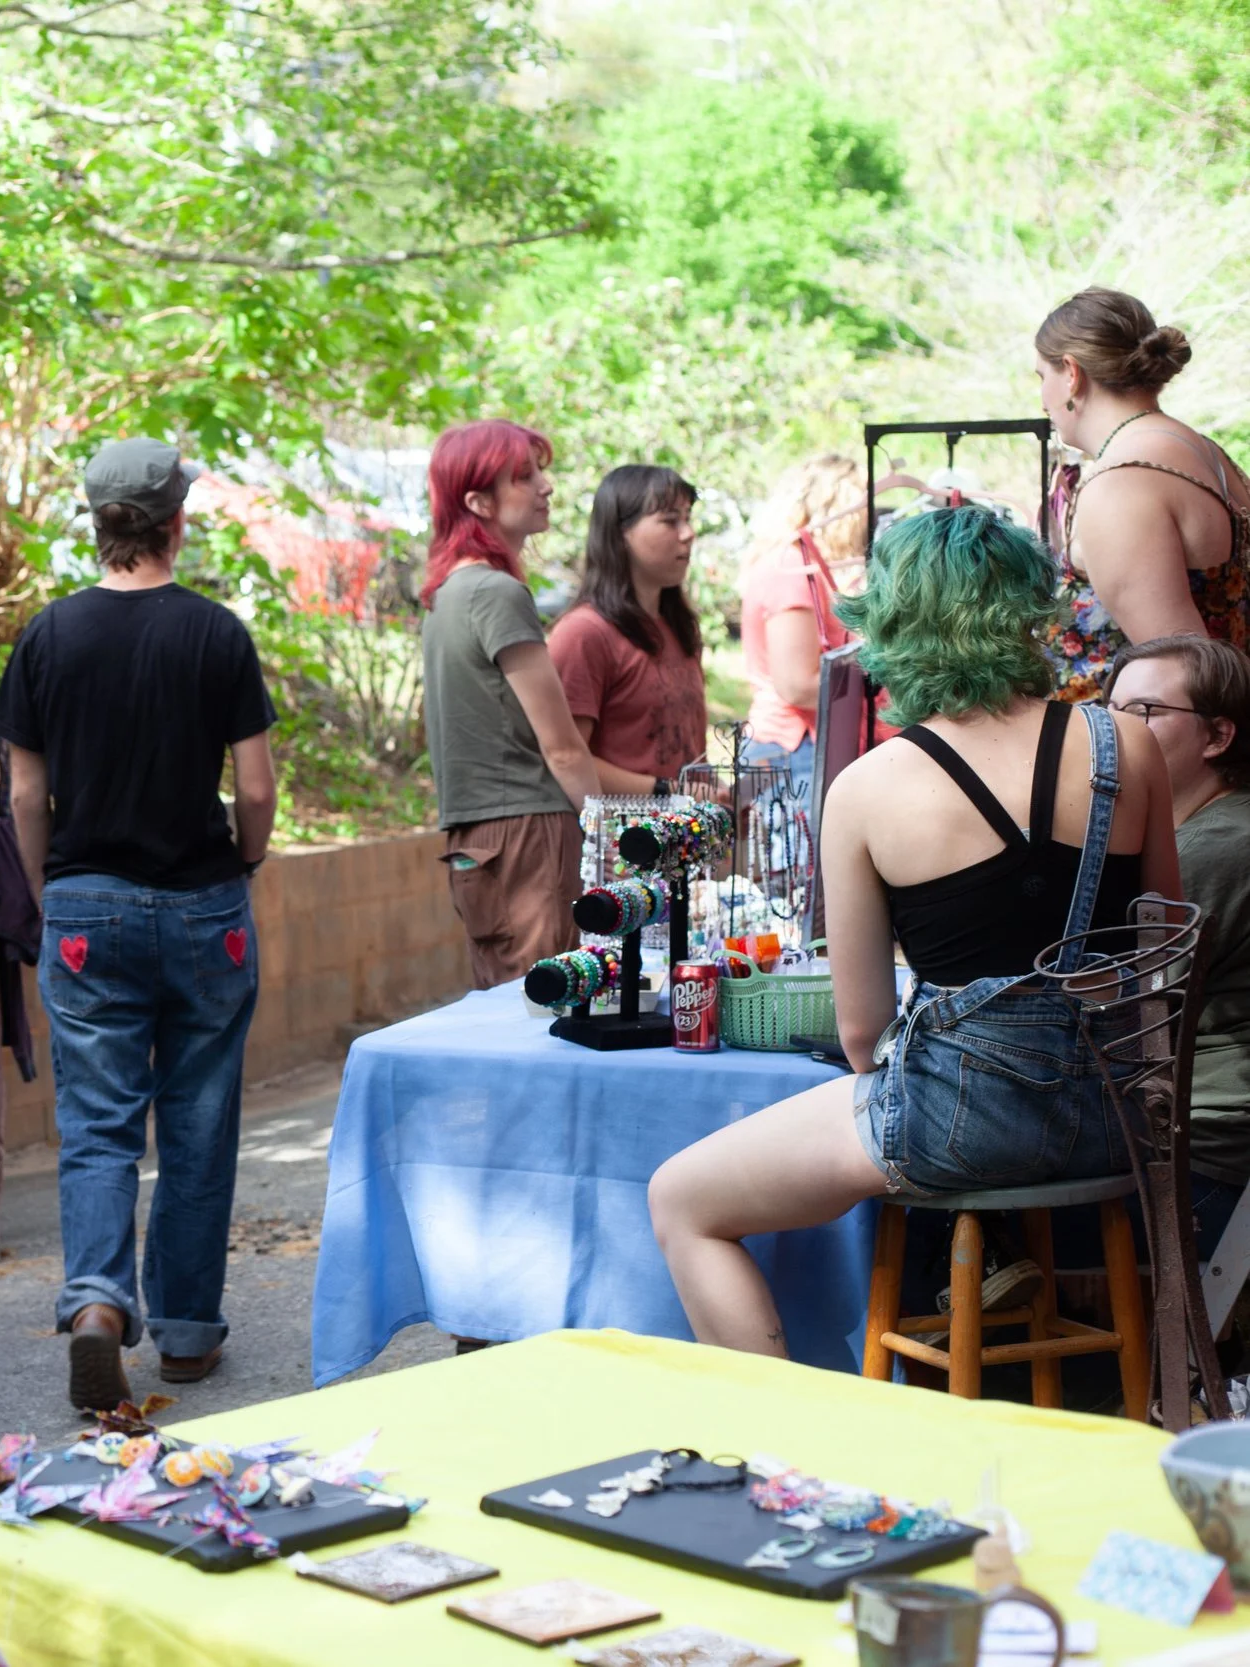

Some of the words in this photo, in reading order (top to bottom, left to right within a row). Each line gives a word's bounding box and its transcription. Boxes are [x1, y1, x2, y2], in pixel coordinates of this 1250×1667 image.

[685, 981, 704, 996] Dr
[673, 983, 714, 1010] Pepper
[680, 1015, 691, 1025] 23
